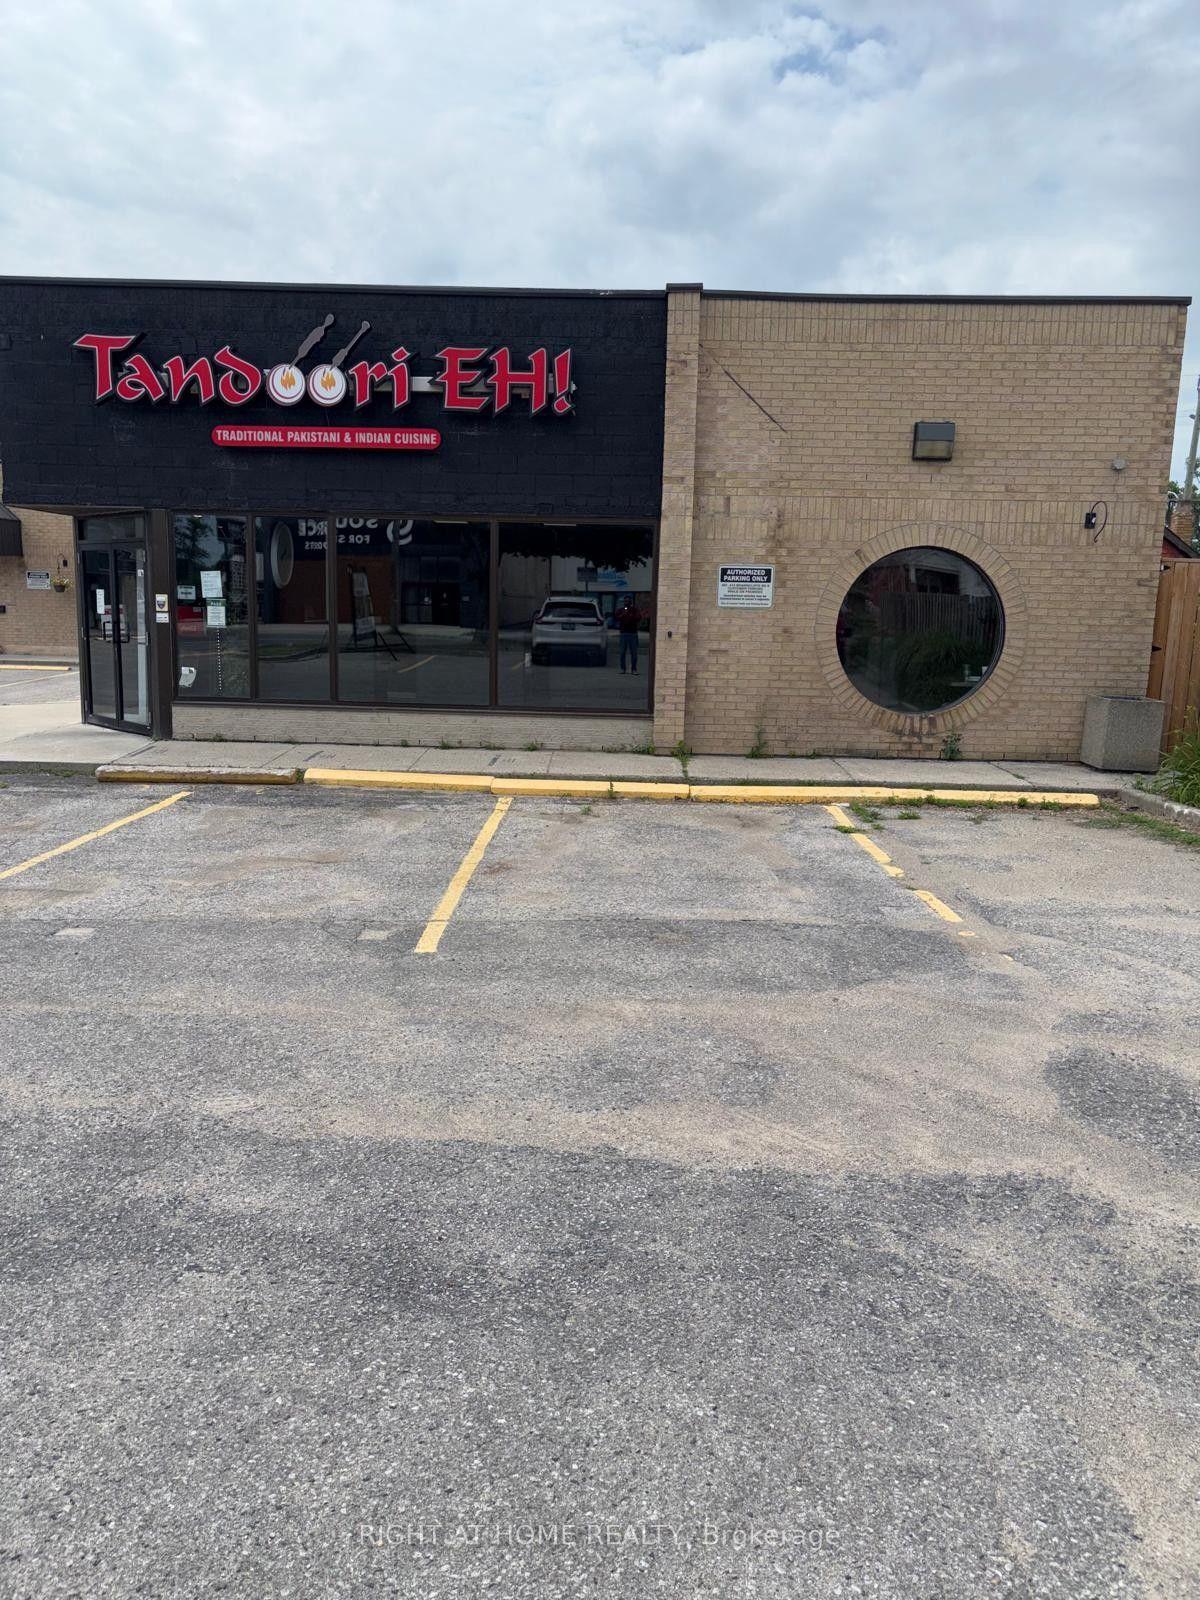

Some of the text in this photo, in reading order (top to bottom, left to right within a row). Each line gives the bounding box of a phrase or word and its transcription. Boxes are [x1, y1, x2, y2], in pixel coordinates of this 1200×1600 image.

[73, 331, 574, 415] Tandoori EH!
[215, 429, 437, 445] TRADITIONAL PAKISTANI & INDIAN CUISINE
